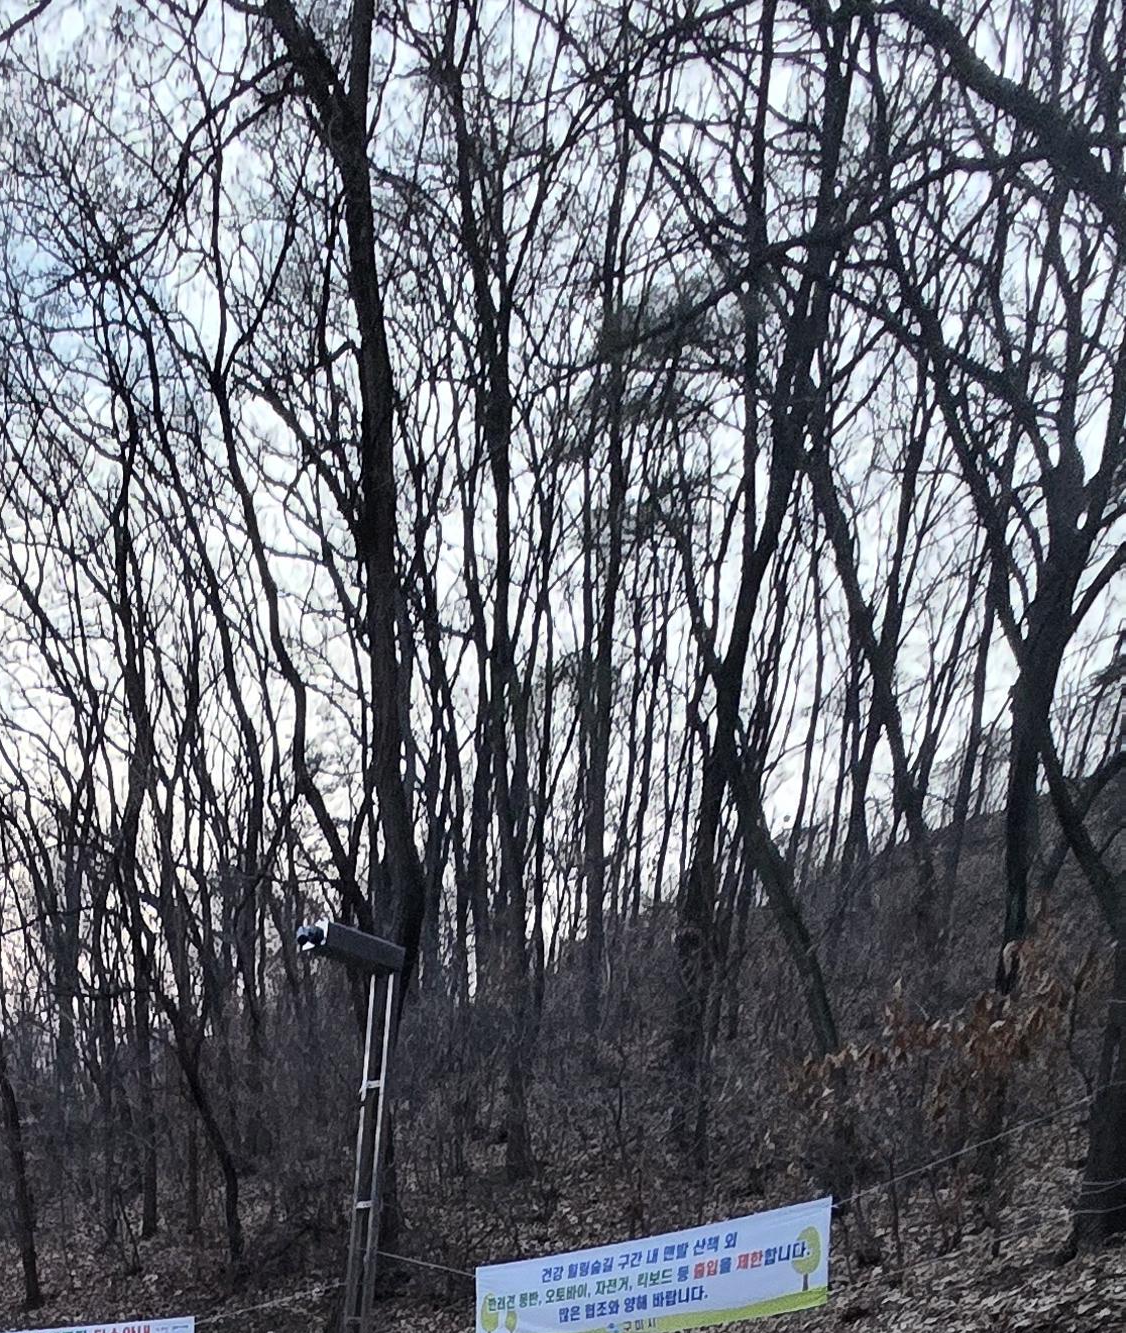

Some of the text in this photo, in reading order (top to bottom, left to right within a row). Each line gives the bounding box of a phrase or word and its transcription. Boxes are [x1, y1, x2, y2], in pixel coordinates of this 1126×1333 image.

[541, 1232, 737, 1284] 건강 힐링숲길 구간 내 맨발 산책 외
[545, 1281, 591, 1304] 오토바이,
[594, 1275, 633, 1296] 자전거,
[736, 1241, 811, 1272] 제한합니다.
[558, 1285, 708, 1324] 많은 협조와 양해 바랍니다.
[622, 1319, 656, 1332] 구미시
